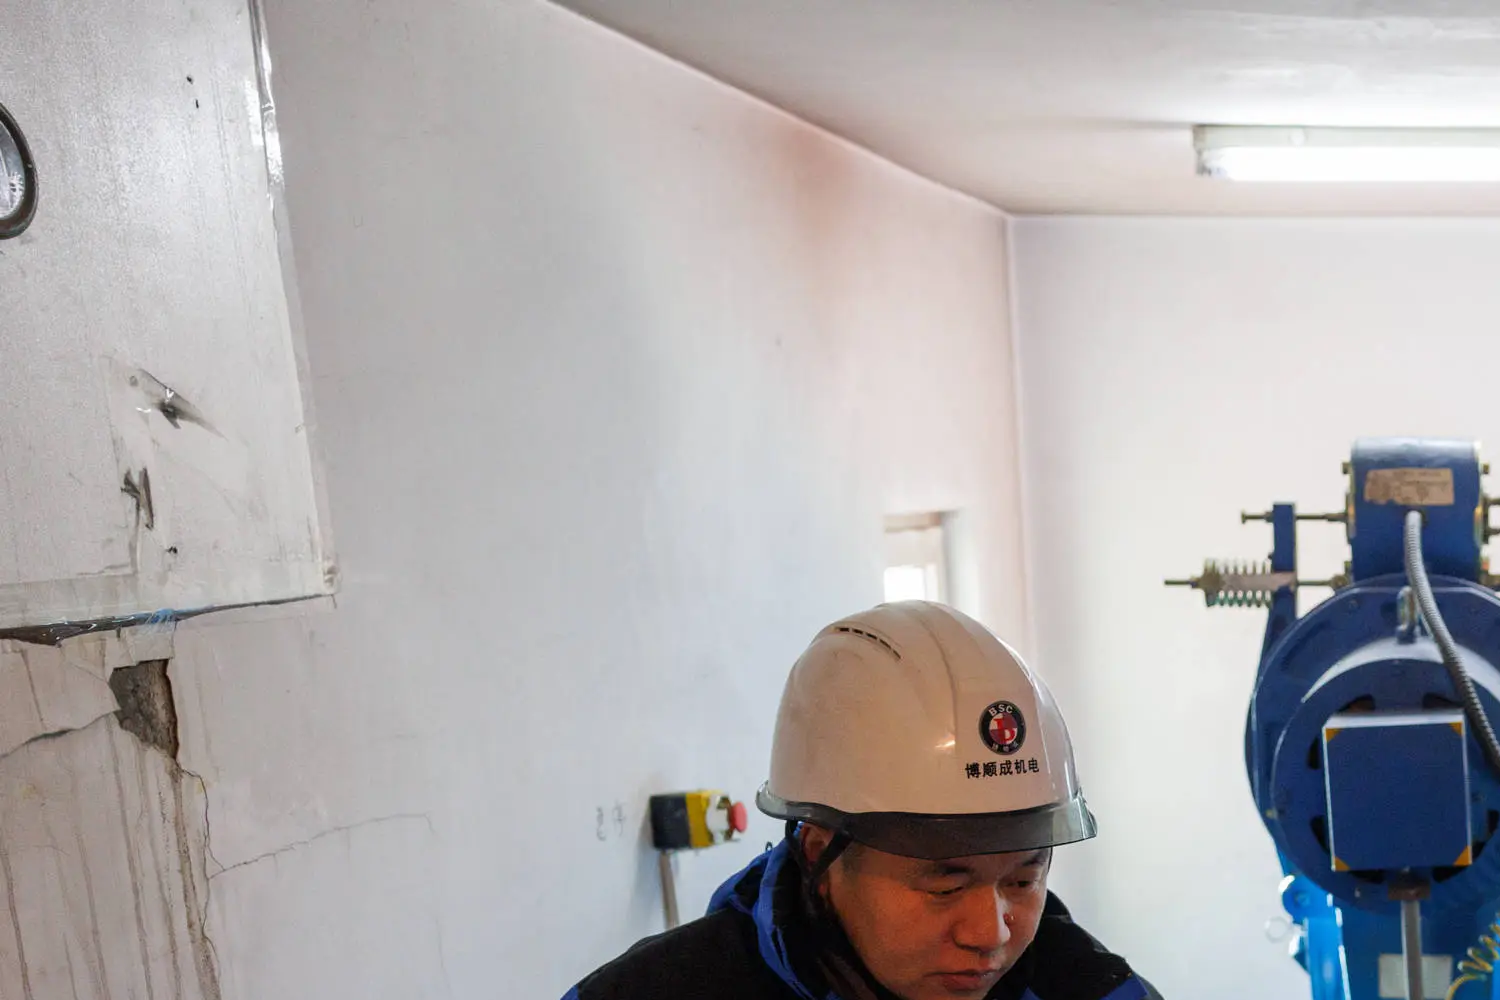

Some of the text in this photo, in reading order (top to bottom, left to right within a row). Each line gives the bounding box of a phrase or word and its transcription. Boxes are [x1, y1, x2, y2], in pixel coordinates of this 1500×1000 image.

[988, 704, 1013, 717] BSC
[965, 758, 1040, 779] 博顺成机电
